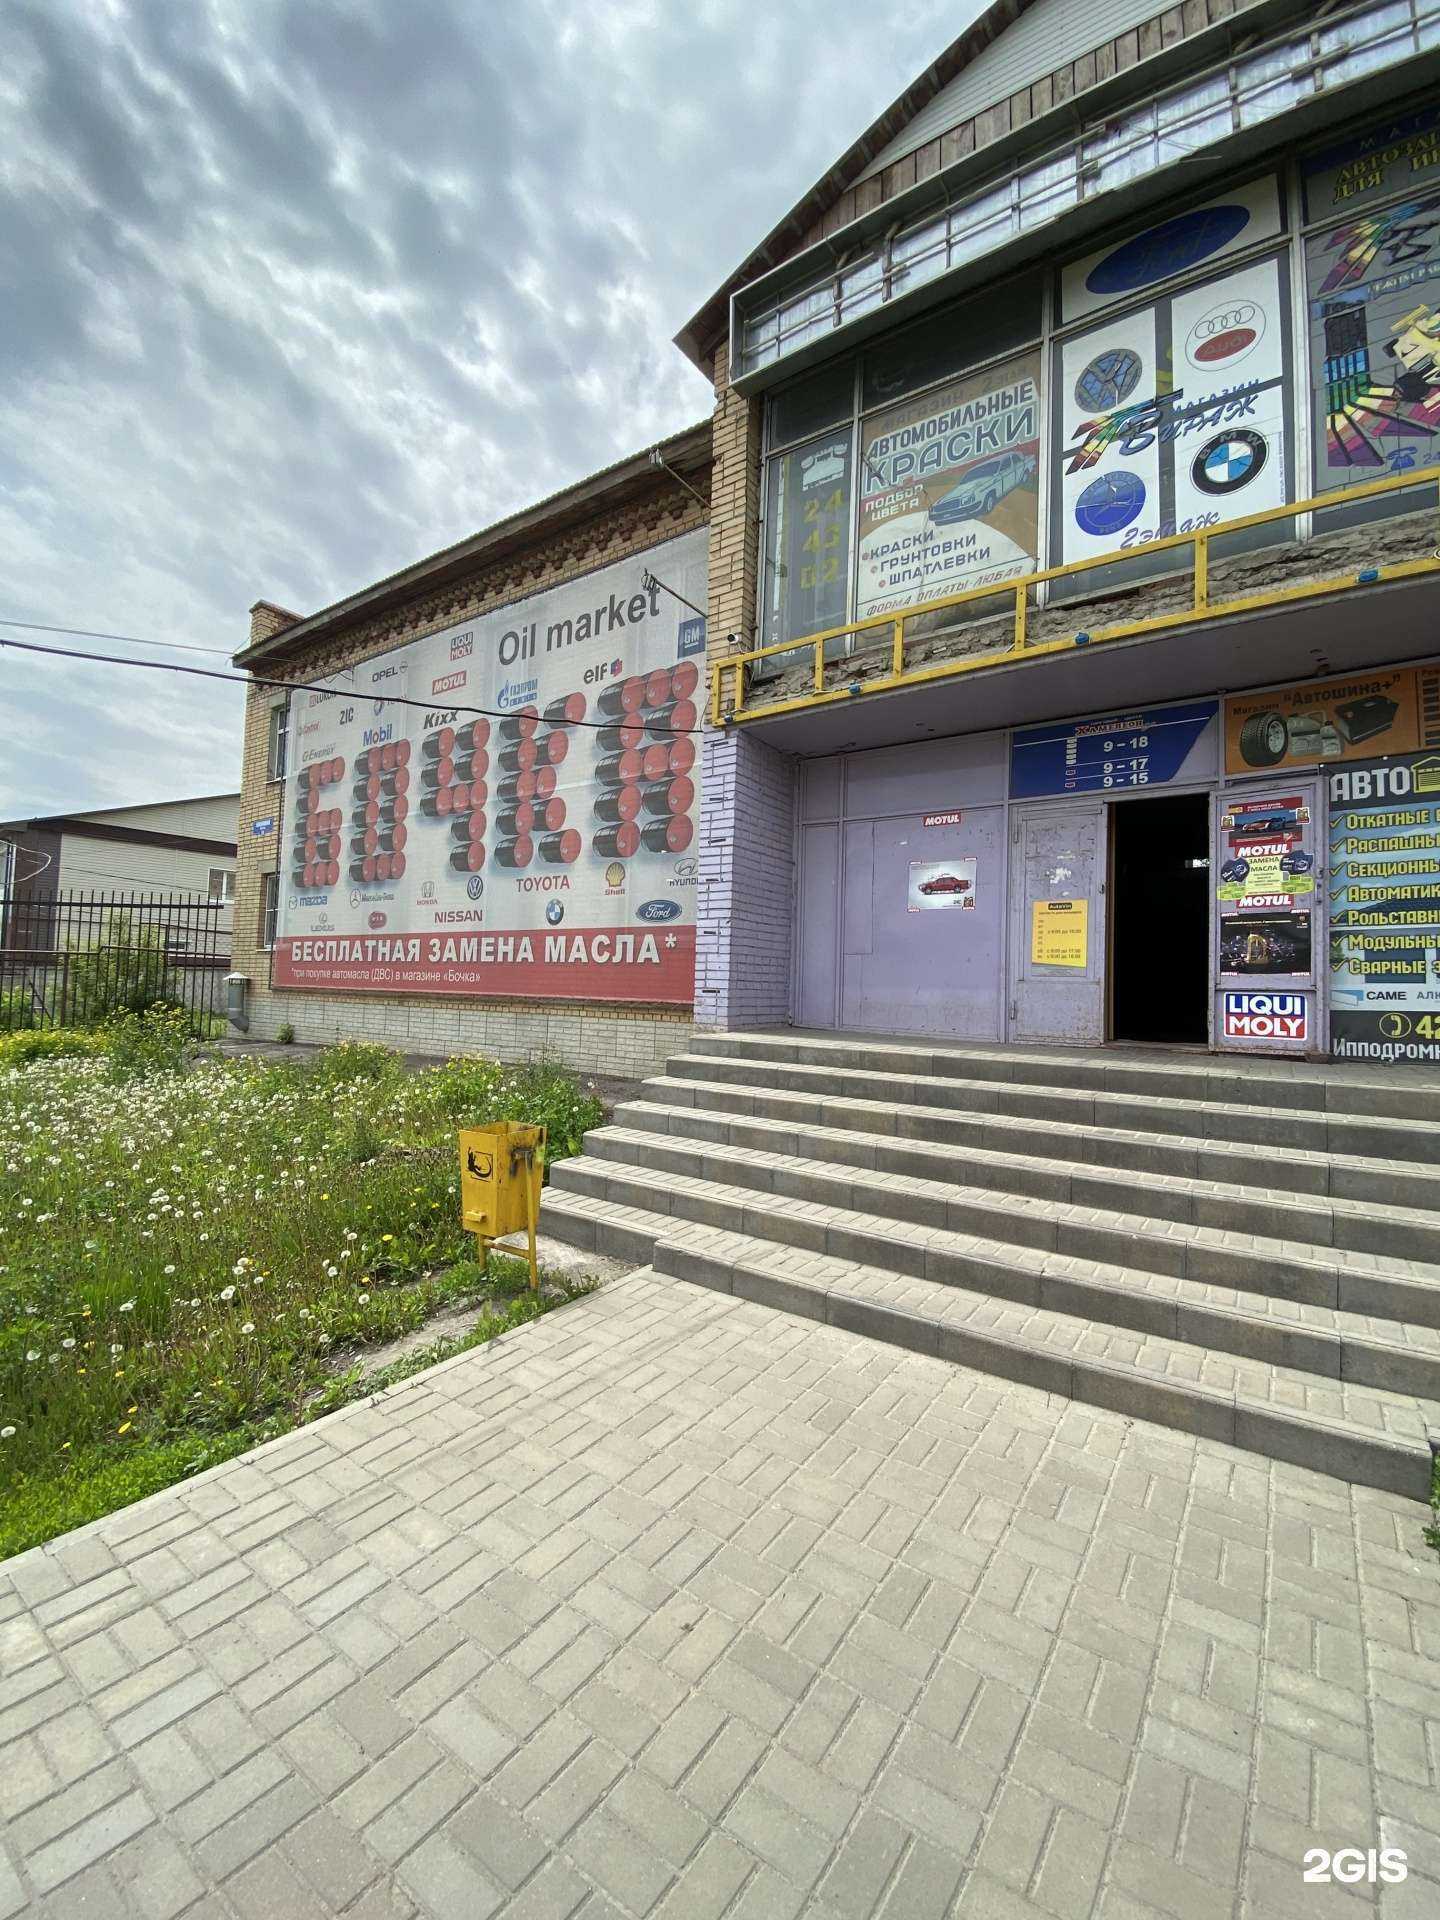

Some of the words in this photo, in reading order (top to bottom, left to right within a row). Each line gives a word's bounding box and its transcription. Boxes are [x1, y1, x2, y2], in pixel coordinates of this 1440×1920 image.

[870, 380, 1033, 460] АВТОМОБИЛЬНЫЕ
[866, 407, 1034, 493] КРАСКИ
[865, 484, 924, 513] ПОДБОР
[871, 529, 934, 560] КРАСКИ
[880, 533, 977, 572] ГРУНТОВКИ
[889, 546, 991, 586] ШПАТЛЕВКИ
[498, 623, 537, 666] Oil
[546, 583, 661, 652] market
[451, 632, 474, 648] LIQUI
[450, 645, 472, 661] MOLY
[372, 667, 398, 683] OPEL
[583, 662, 608, 685] elf
[433, 672, 466, 694] MOTUL
[510, 679, 538, 696] ГАЗПРОМ
[339, 707, 355, 726] ZIC
[423, 709, 459, 730] Kixx
[362, 723, 393, 747] Mobil
[1103, 741, 1114, 752] 9
[1129, 736, 1149, 749] 18
[1103, 762, 1114, 773] 9
[1129, 758, 1149, 771] 17
[1103, 776, 1114, 788] 9
[1129, 772, 1149, 784] 15
[1330, 766, 1410, 802] АВТО
[925, 814, 961, 826] MOTUL
[1238, 844, 1290, 857] MOTUL
[1248, 856, 1280, 865] ЗАМЕНА
[1250, 865, 1278, 873] МАСЛА
[516, 875, 571, 893] TOYOTA
[1239, 895, 1292, 907] MOTUL
[434, 909, 483, 924] NISSAN
[644, 904, 671, 919] Ford
[291, 938, 421, 963] БЕСПЛАТНАЯ
[428, 935, 535, 963] ЗАМЕНА
[371, 967, 394, 983] (ДВС)
[402, 970, 441, 981] магазине
[443, 969, 481, 983] «Бочка»
[1229, 995, 1303, 1016] LIQUI
[1229, 1015, 1304, 1037] MOLY
